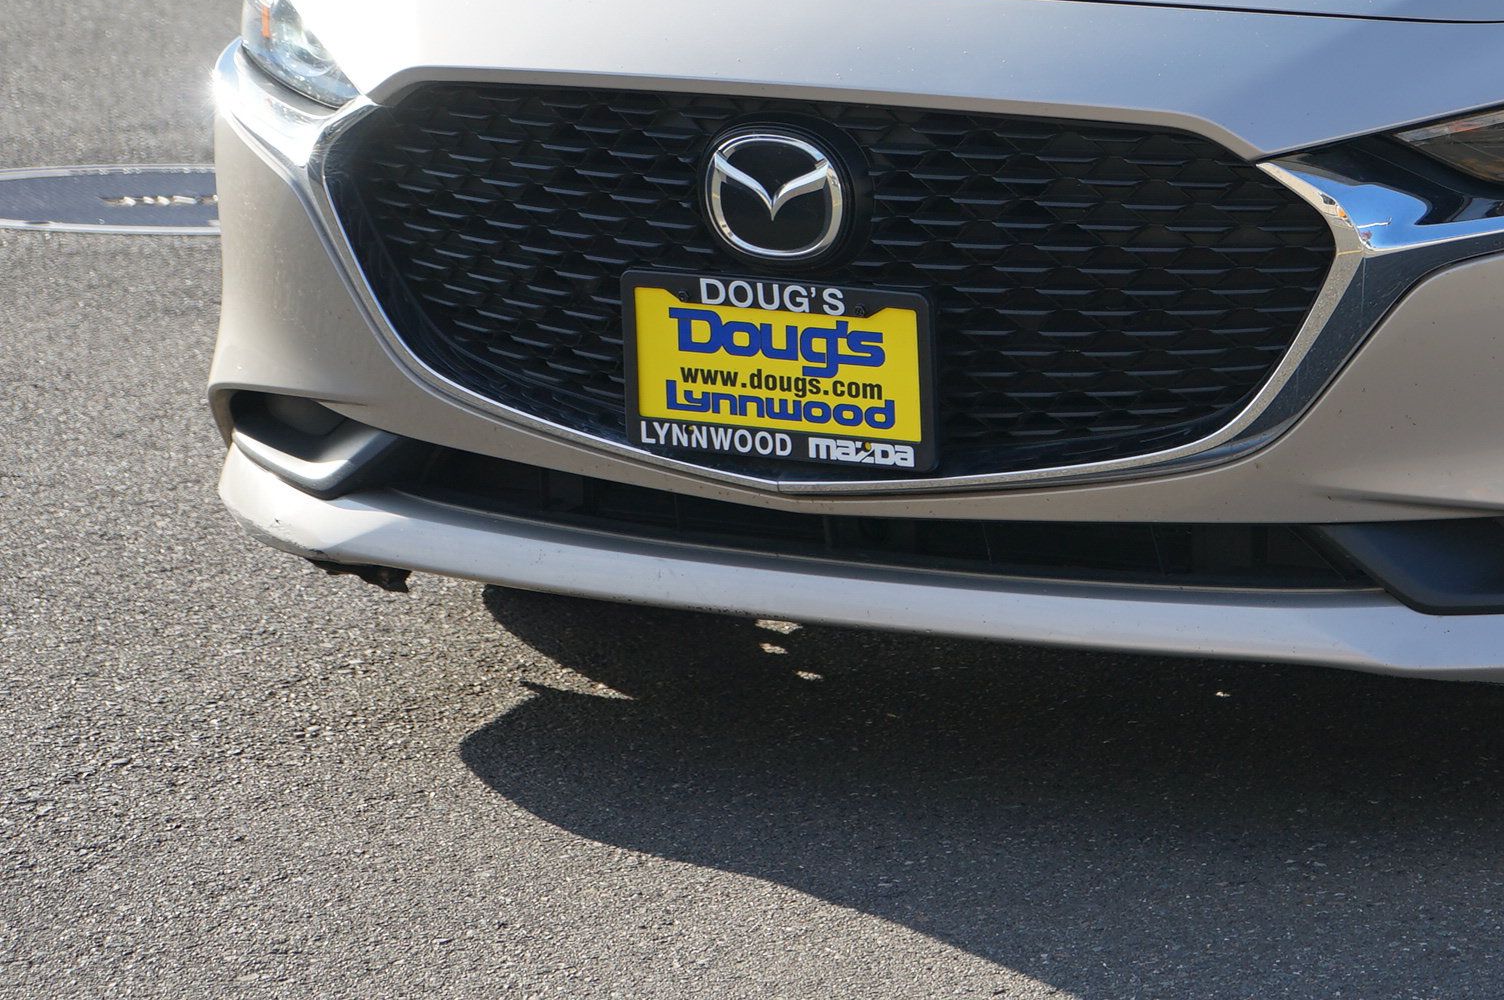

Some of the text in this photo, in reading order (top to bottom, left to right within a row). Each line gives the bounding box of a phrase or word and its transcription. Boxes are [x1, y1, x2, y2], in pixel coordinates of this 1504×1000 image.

[699, 277, 846, 316] DOUG'S
[668, 306, 886, 379] Doug's
[680, 366, 883, 400] www.dougs.com
[665, 379, 896, 430] Lynnwood
[640, 420, 792, 457] LYNNWOOD
